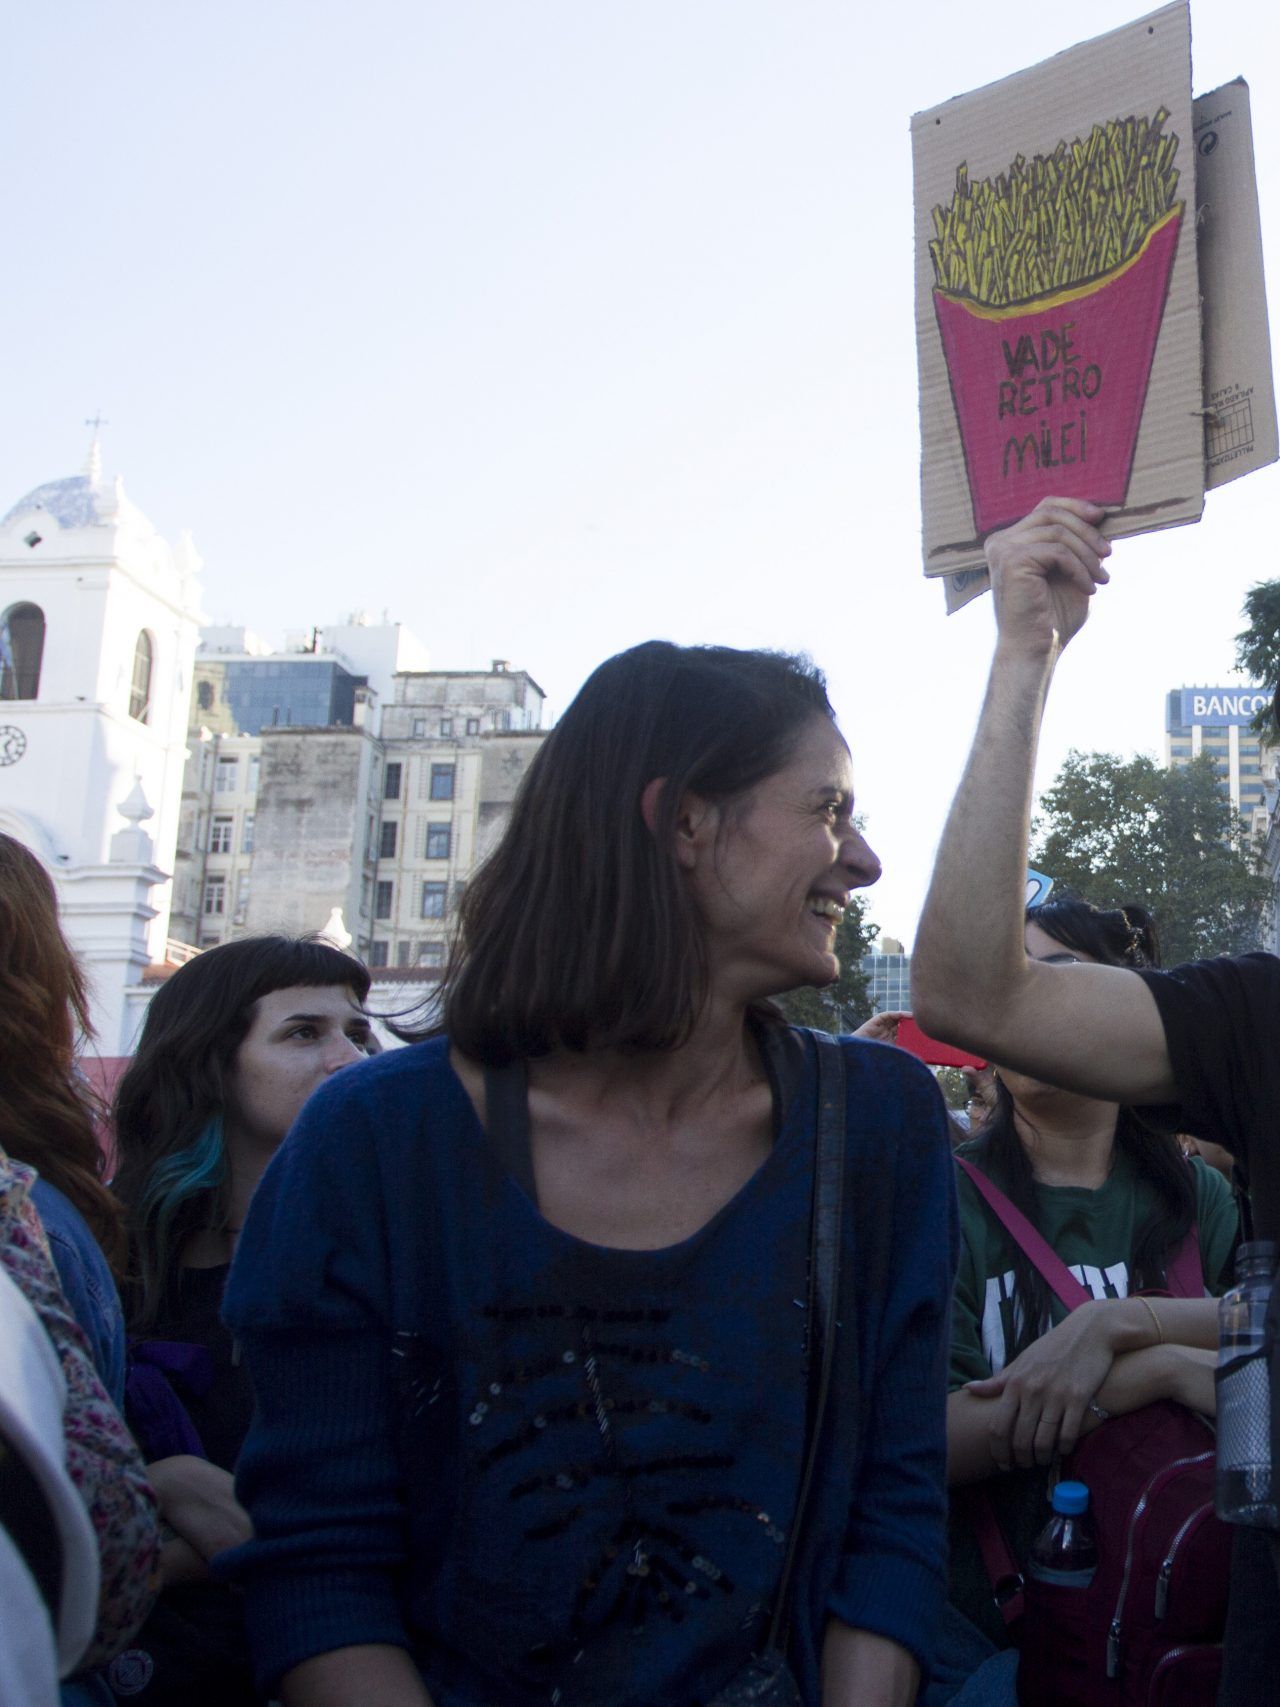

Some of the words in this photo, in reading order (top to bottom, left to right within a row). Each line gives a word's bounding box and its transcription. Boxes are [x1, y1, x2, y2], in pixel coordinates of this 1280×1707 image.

[1002, 320, 1082, 378] VADE
[998, 363, 1102, 421] RETRO
[1002, 409, 1088, 479] MILEI
[1193, 695, 1274, 716] BANCO
